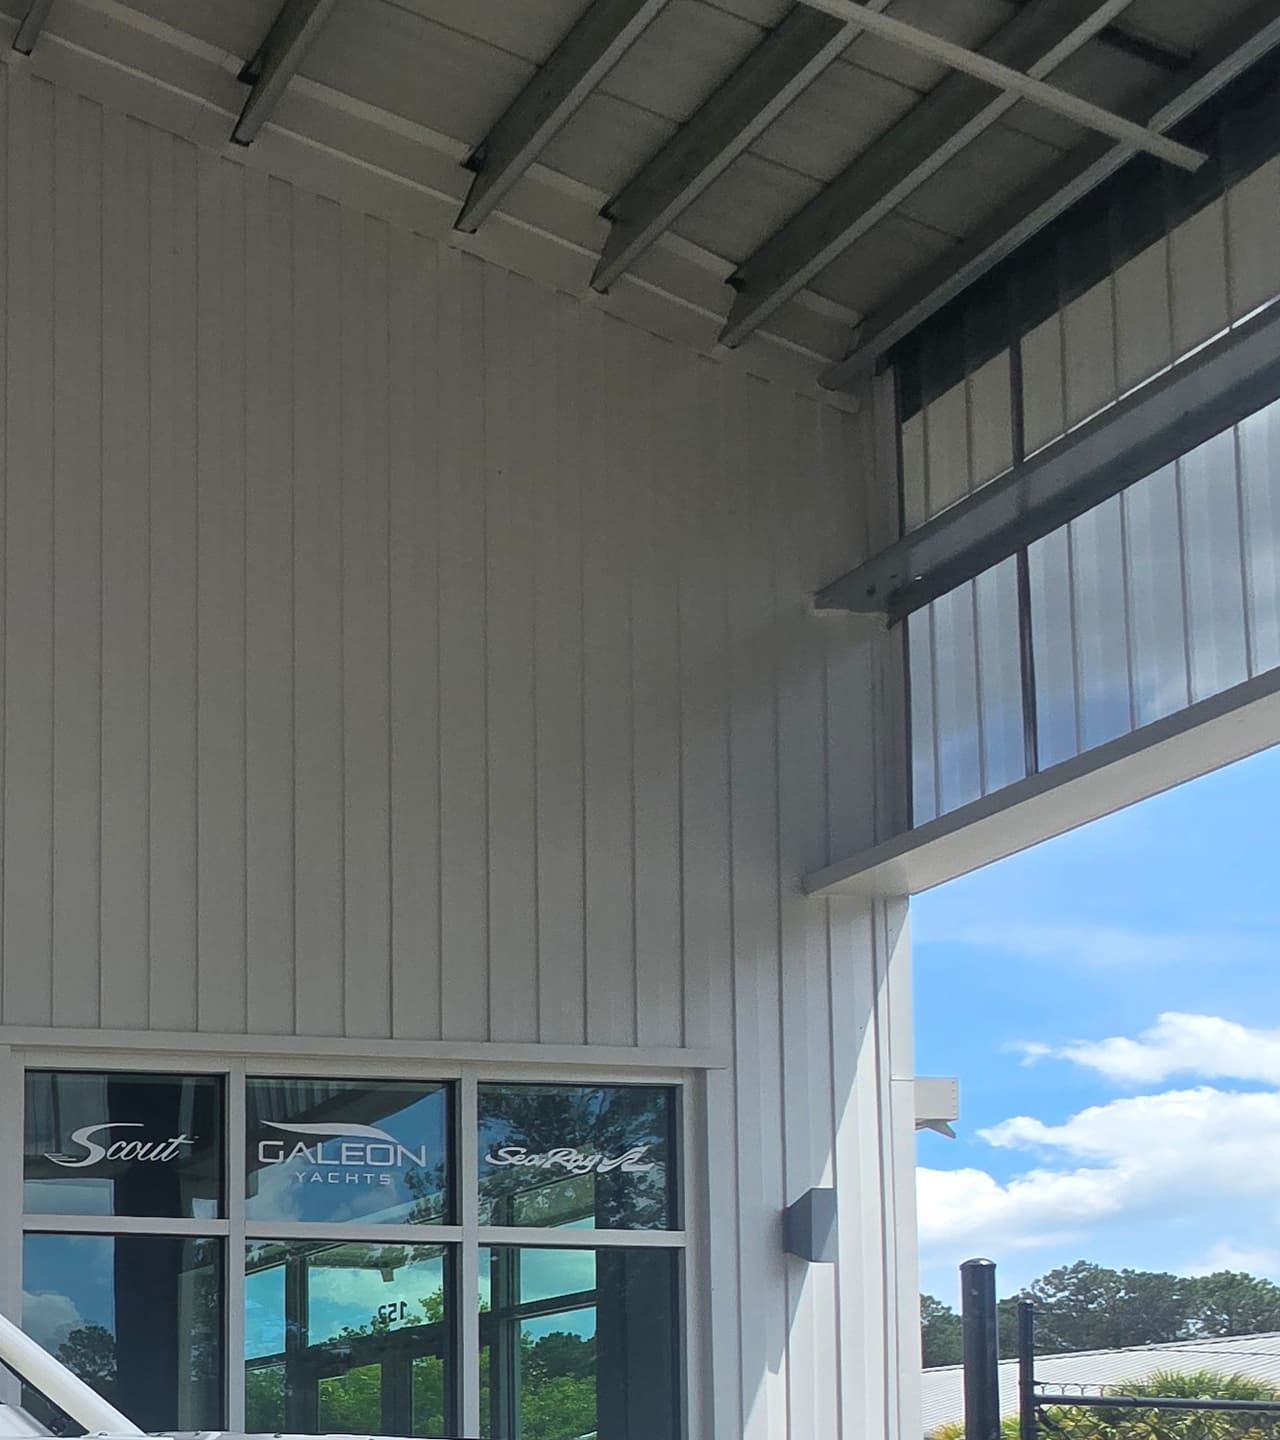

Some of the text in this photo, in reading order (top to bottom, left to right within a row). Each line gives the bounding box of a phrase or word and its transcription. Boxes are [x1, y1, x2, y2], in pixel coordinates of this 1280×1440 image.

[44, 1122, 195, 1168] Scout
[258, 1140, 427, 1168] GALEON
[485, 1146, 603, 1175] Sea Ray
[295, 1171, 391, 1185] YACHTS
